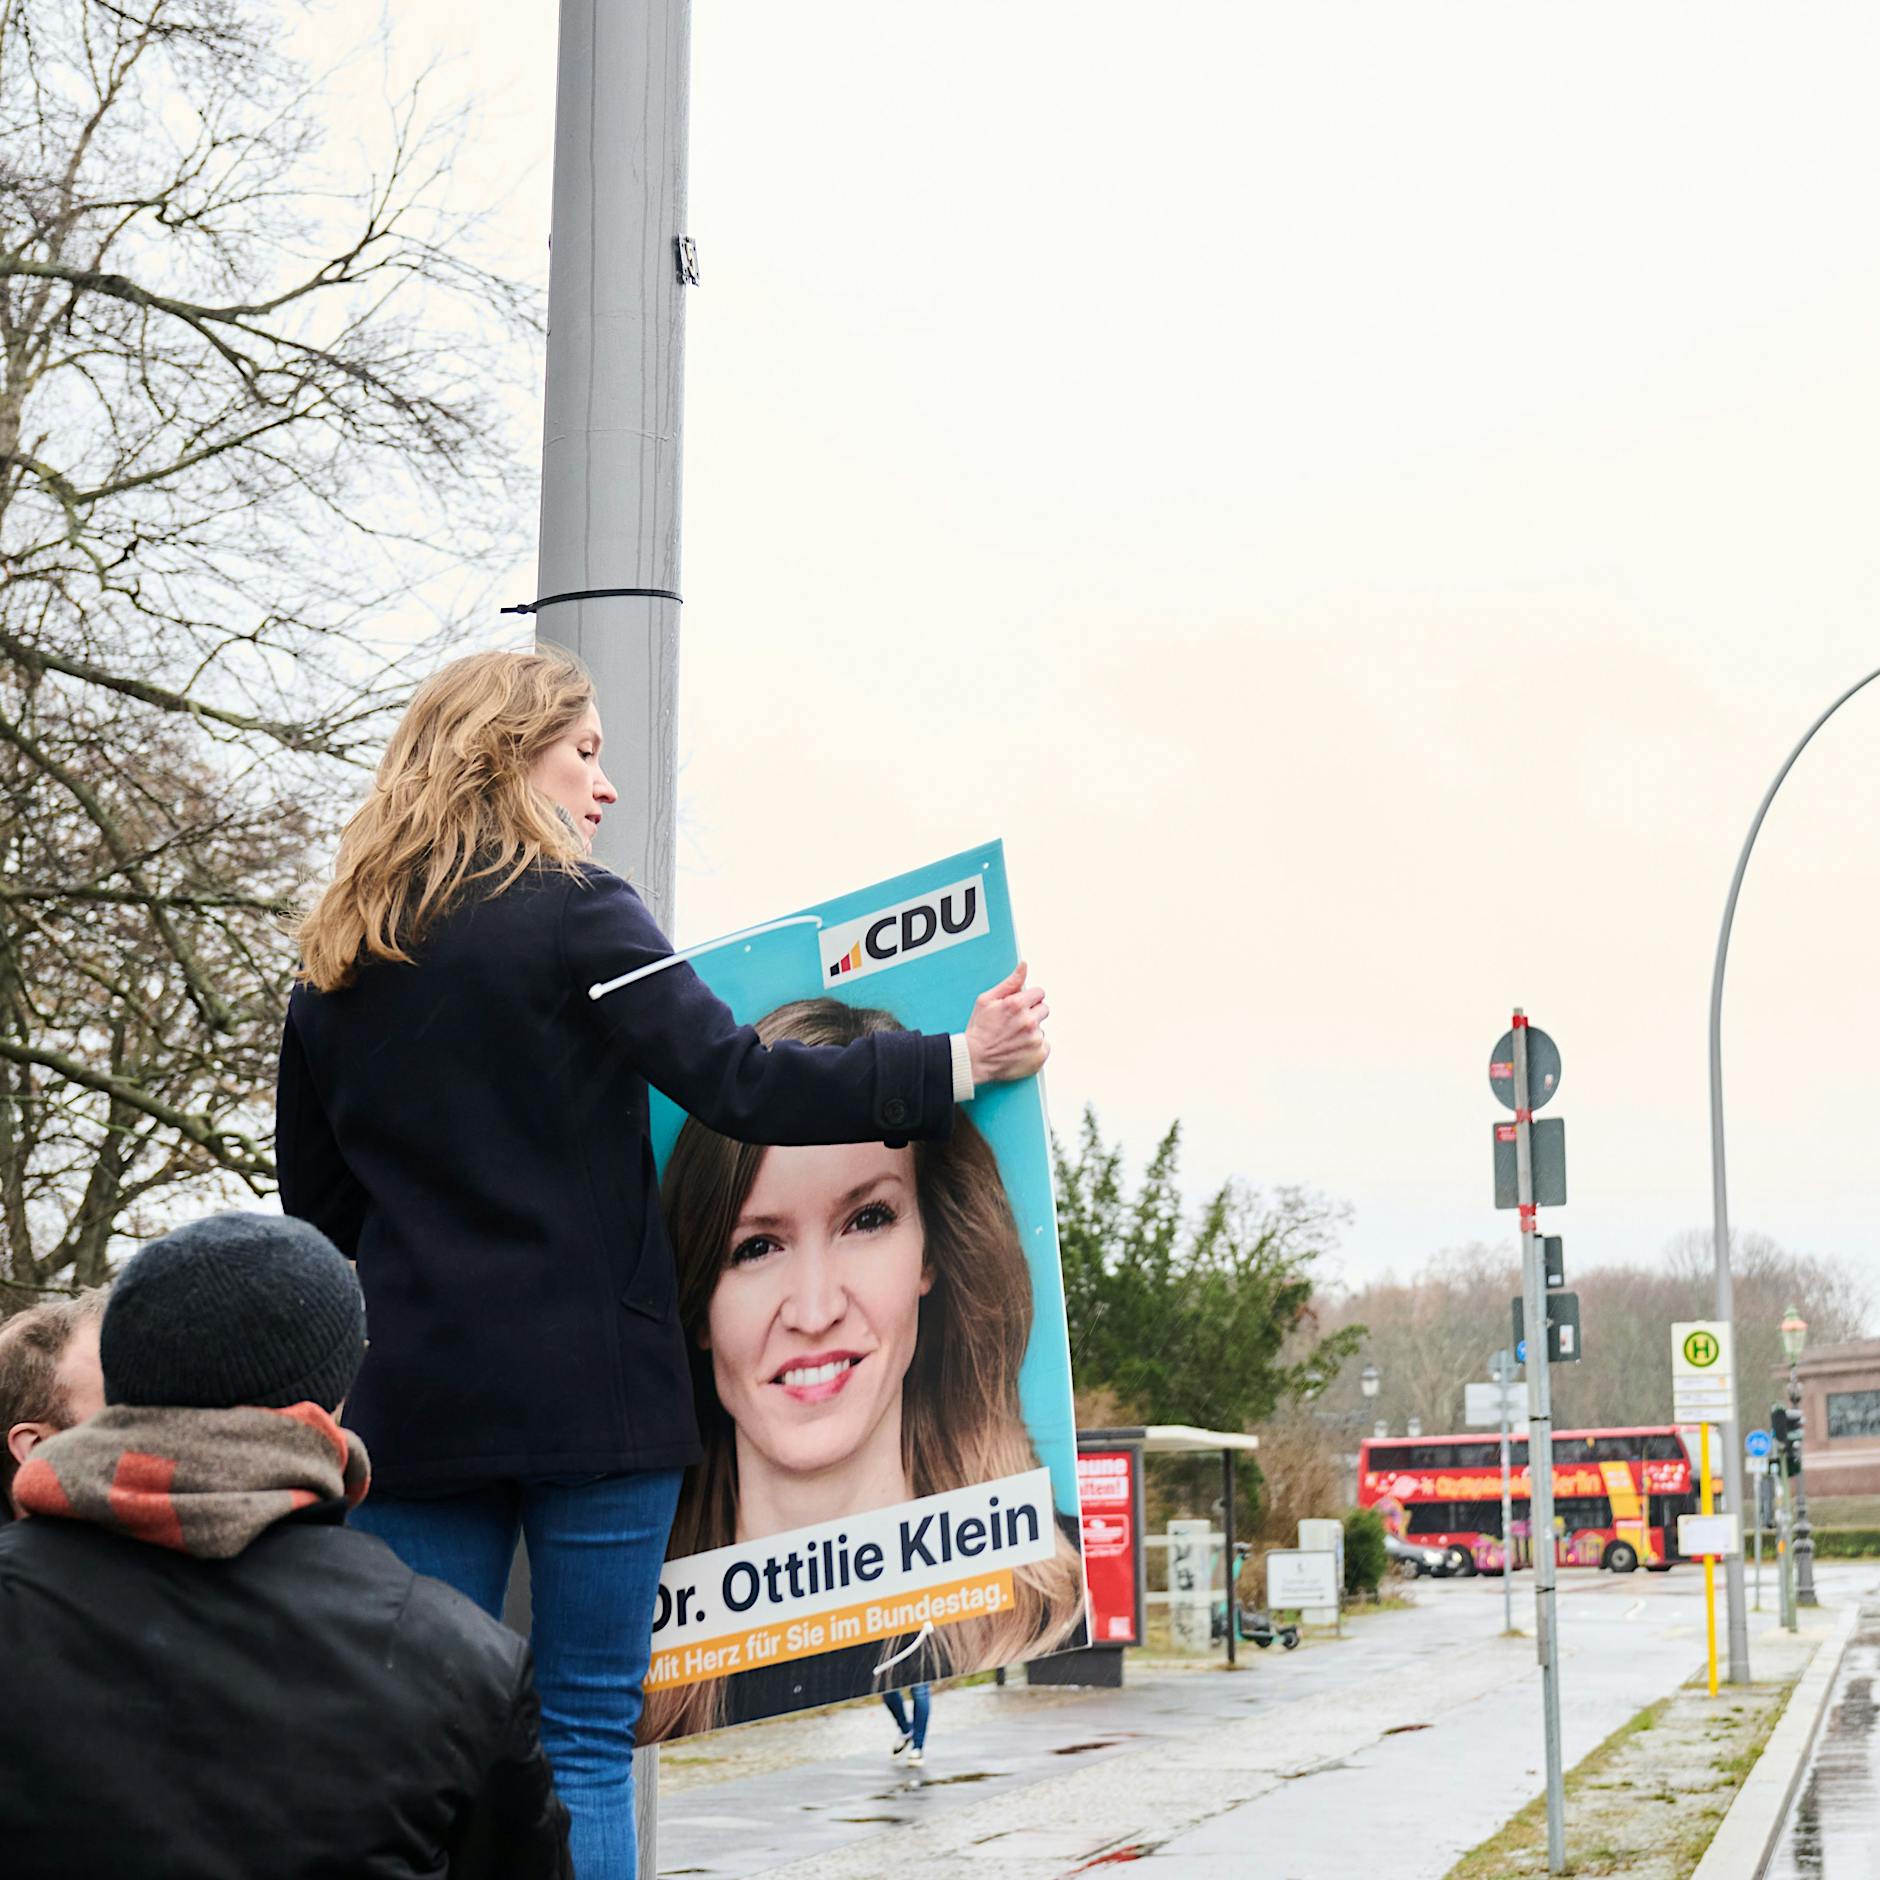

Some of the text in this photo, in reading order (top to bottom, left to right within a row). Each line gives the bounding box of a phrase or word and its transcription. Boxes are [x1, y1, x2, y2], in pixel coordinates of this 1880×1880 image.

[866, 886, 976, 960] CDU
[1693, 1340, 1710, 1359] H
[722, 1534, 884, 1612] Ottilie
[899, 1496, 1039, 1573] Klein
[644, 1581, 1009, 1685] Mit Herz für Sie im Bundestag.
